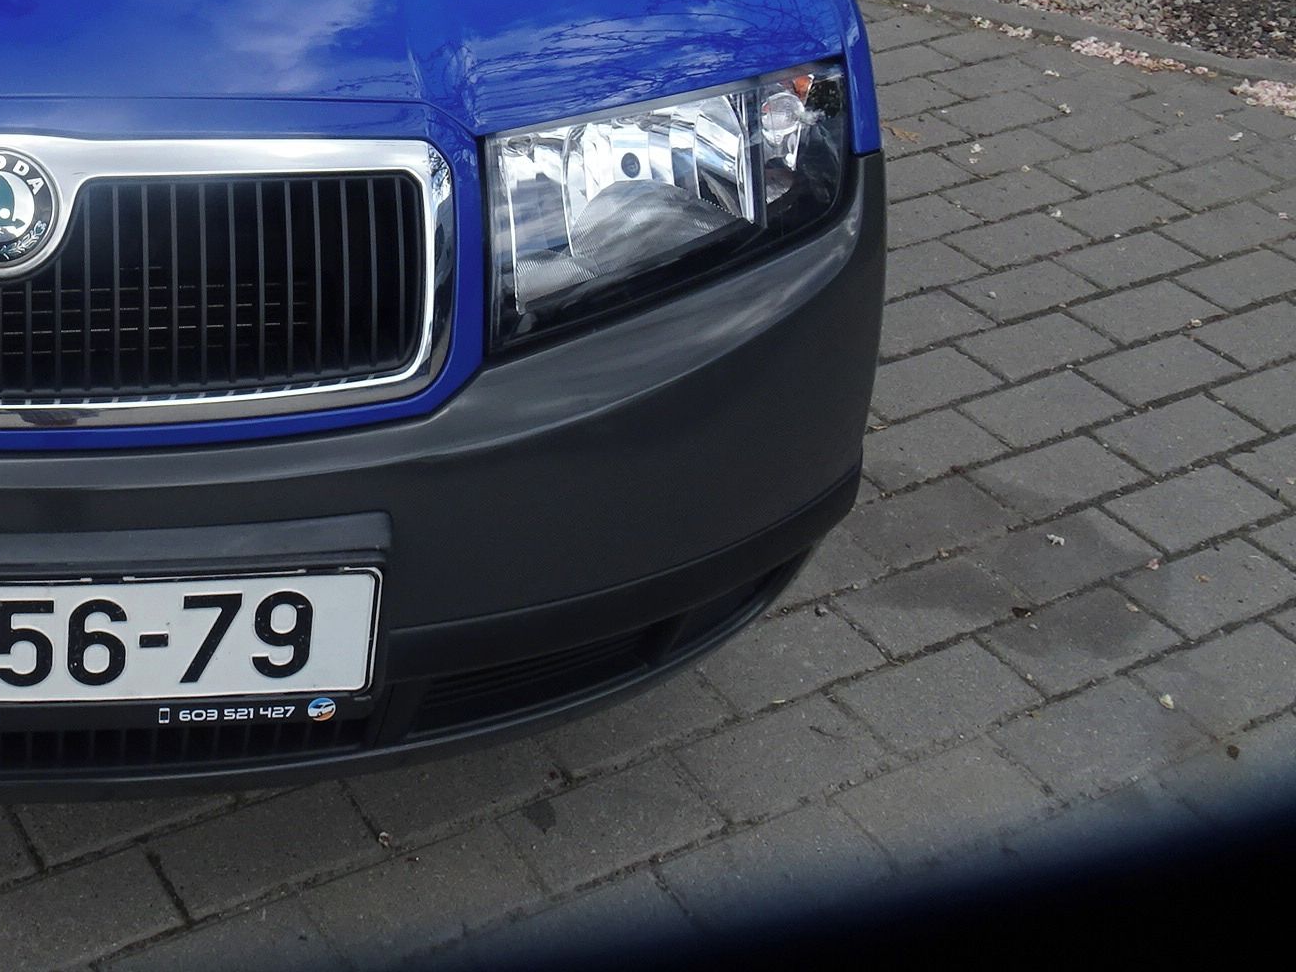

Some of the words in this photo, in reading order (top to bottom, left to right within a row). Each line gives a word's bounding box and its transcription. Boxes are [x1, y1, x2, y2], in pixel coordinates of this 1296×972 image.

[178, 709, 218, 722] 603
[223, 707, 254, 720] 521
[259, 706, 296, 718] 427
